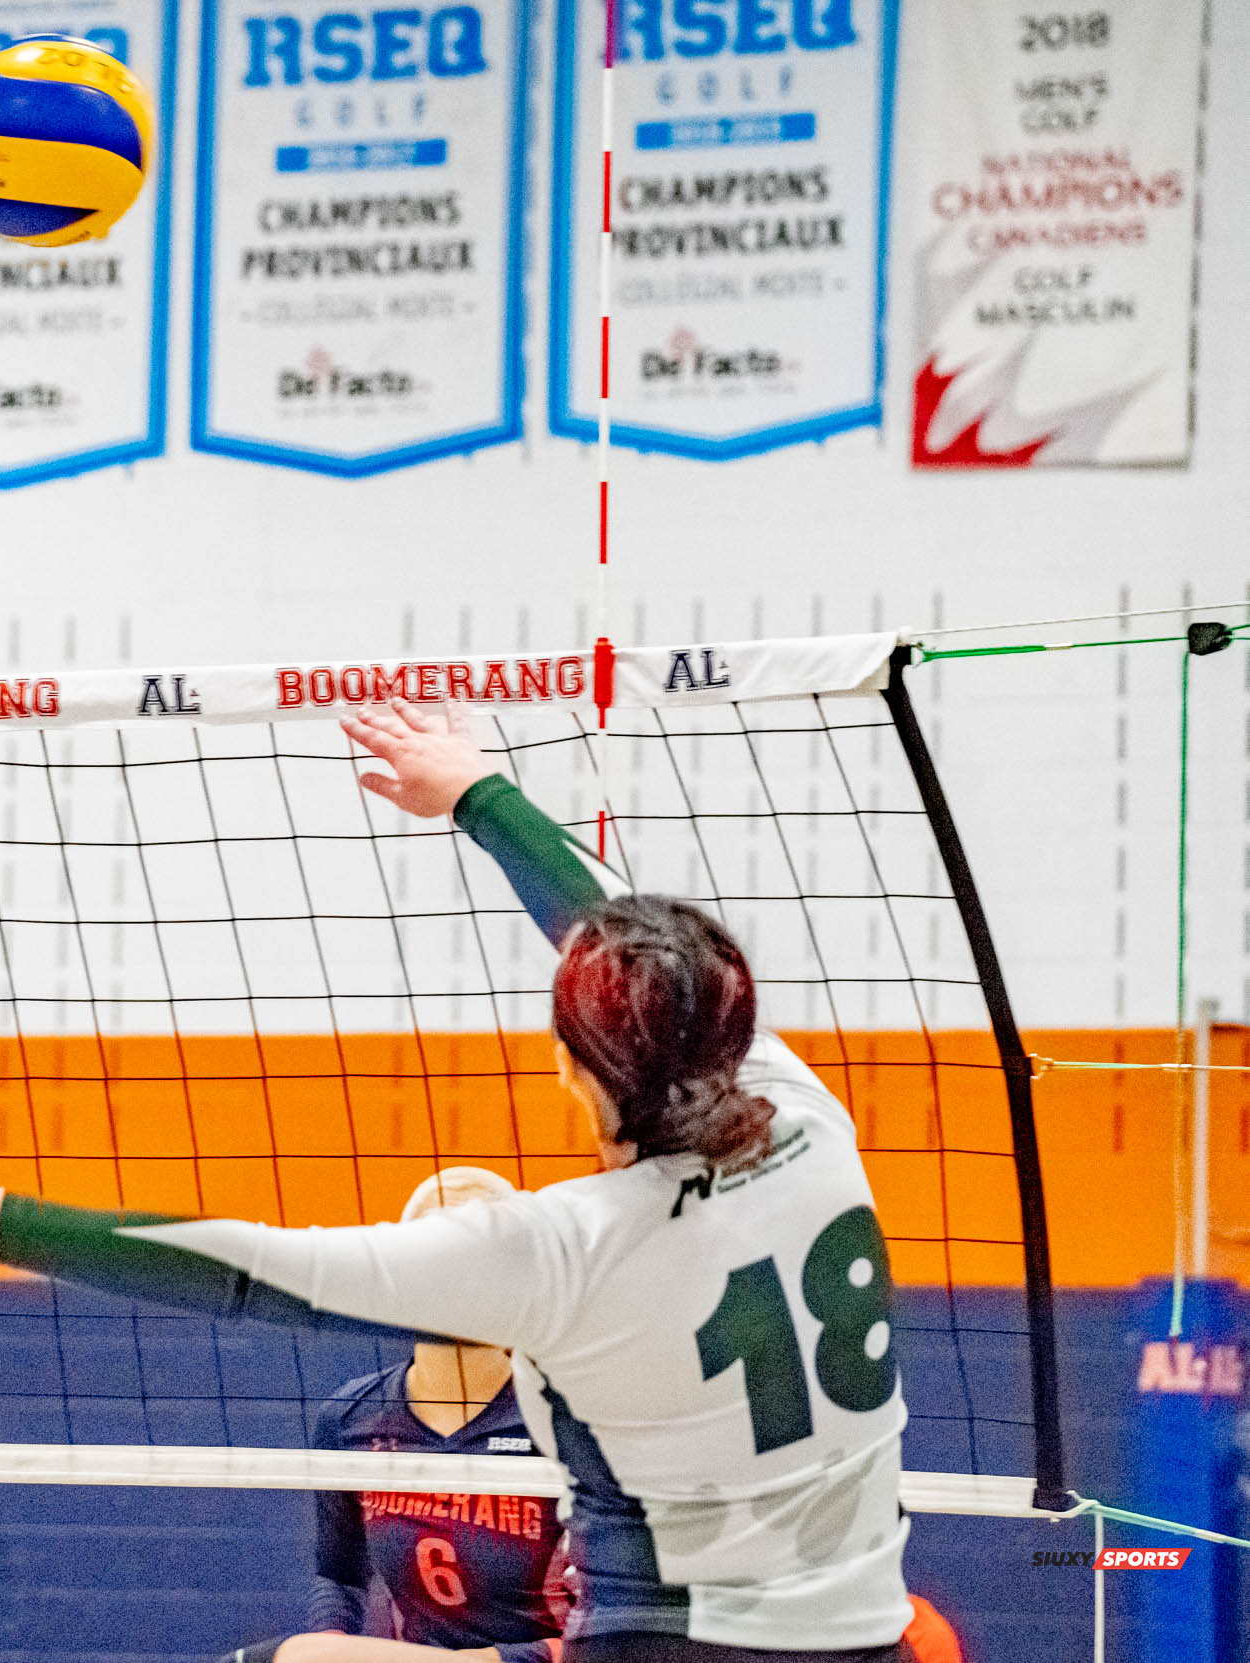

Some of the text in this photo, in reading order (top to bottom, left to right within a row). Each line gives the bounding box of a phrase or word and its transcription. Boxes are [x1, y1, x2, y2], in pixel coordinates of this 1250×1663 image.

[244, 5, 487, 87] RSEQ
[1021, 12, 1110, 51] 2018
[261, 192, 460, 231] CHAMPIONS
[620, 169, 828, 211] CHAMPIONS
[932, 170, 1184, 219] CHAMPIONS
[243, 241, 472, 278] PROVINCIAUX
[276, 656, 584, 709] BOOMERANG
[695, 1204, 899, 1455] 18
[415, 1537, 468, 1606] 6
